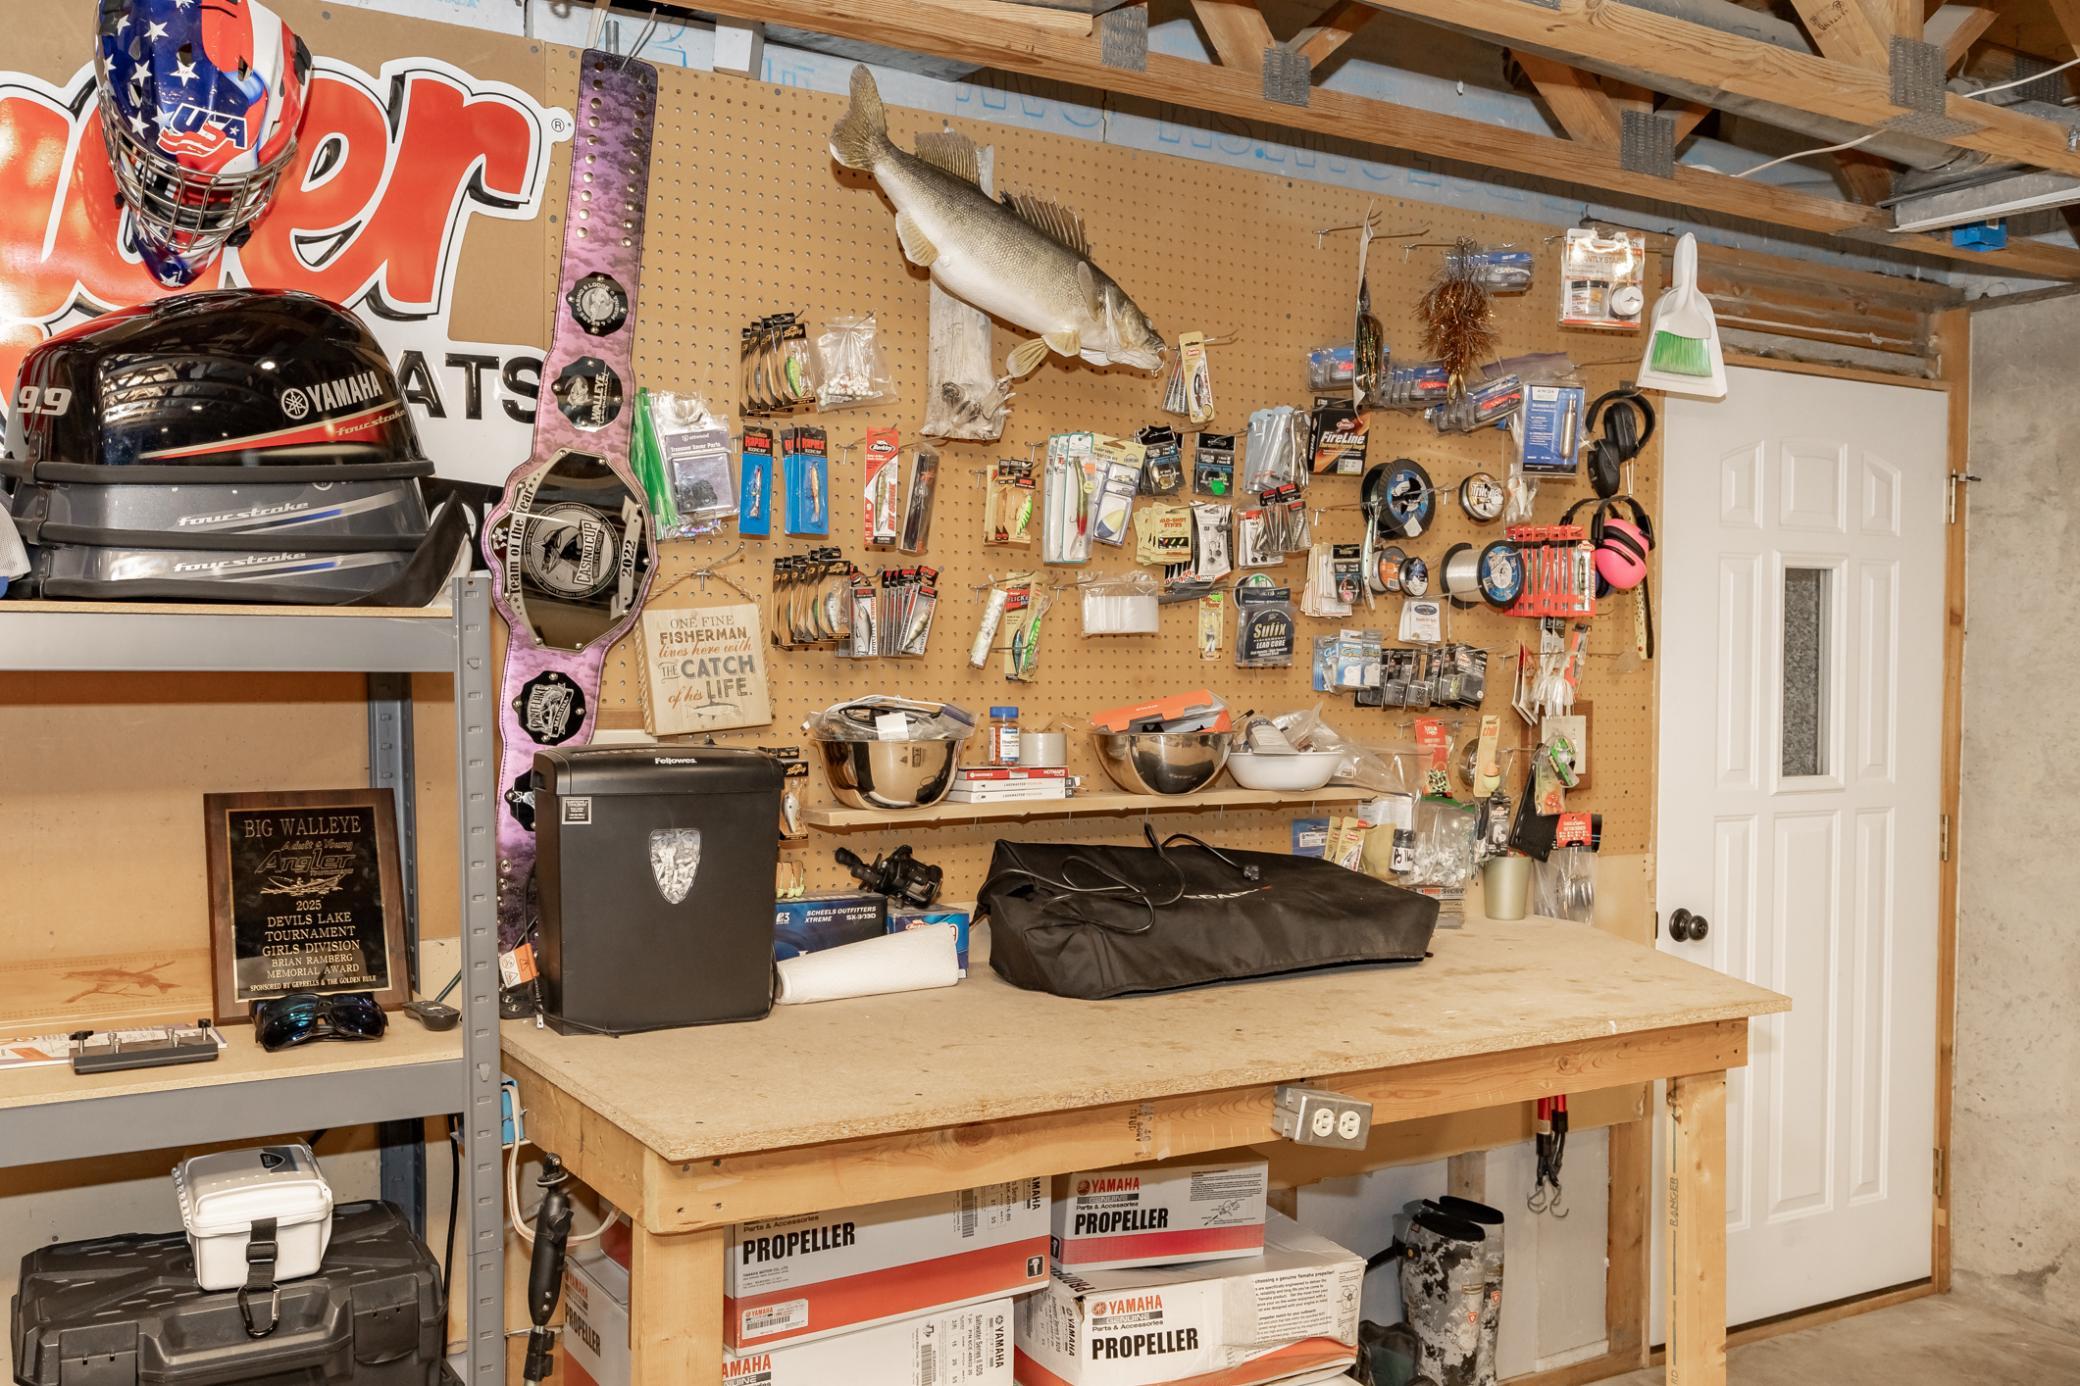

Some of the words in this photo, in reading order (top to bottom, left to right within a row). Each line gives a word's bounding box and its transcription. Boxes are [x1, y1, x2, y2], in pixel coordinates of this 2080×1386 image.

[157, 103, 247, 157] USA
[16, 385, 72, 417] 9.9
[307, 370, 383, 413] YAMAHA
[1320, 431, 1365, 445] FireLine
[515, 487, 534, 514] Year
[511, 519, 524, 538] the
[582, 522, 597, 544] CUP
[510, 543, 520, 557] of
[621, 540, 636, 578] 2022
[577, 545, 594, 584] CASINO
[509, 561, 521, 595] Team
[670, 615, 698, 629] ONE
[702, 614, 735, 627] FINE
[1253, 622, 1287, 639] Sufix
[659, 626, 748, 646] FISHERMAN
[723, 636, 753, 654] with
[681, 654, 756, 679] CATCH
[668, 686, 683, 709] of
[684, 685, 704, 702] his
[244, 818, 273, 838] BIG
[280, 815, 361, 835] WALLEYE
[254, 848, 356, 875] Angler
[296, 900, 322, 911] 2025
[806, 908, 837, 917] SCHEELS
[837, 906, 877, 915] OUTFITTERS
[267, 914, 313, 928] DEVILS
[317, 912, 352, 924] LAKE
[804, 915, 833, 924] XTREME
[264, 926, 356, 942] TOURNAMENT
[262, 943, 300, 957] GIRLS
[305, 939, 360, 954] DIVISION
[271, 956, 302, 968] BRIAN
[306, 953, 353, 965] RAMBERG
[266, 966, 320, 979] MEMORIAL
[324, 963, 360, 974] AWARD
[250, 982, 282, 992] SPONSORED
[327, 977, 338, 986] THE
[339, 975, 361, 985] GOLDEN
[361, 974, 377, 983] RULE
[1032, 1177, 1041, 1210] AMAHA
[1092, 1177, 1140, 1193] YAMAHA
[774, 1215, 819, 1227] Accessories
[1074, 1207, 1168, 1235] PROPELLER
[743, 1222, 855, 1265] PROPELLER
[752, 1306, 774, 1317] YAMAHA
[1109, 1295, 1162, 1314] YAMAHA
[565, 1302, 601, 1357] PROPELLER
[975, 1314, 983, 1340] Saltwater
[1092, 1325, 1112, 1333] Parts
[1121, 1319, 1163, 1331] Accessories
[995, 1326, 1004, 1368] YAMAHA
[1067, 1318, 1075, 1357] YAMAHA
[1092, 1328, 1198, 1360] PROPELLER
[975, 1341, 983, 1358] Series
[722, 1354, 772, 1378] AMAHA
